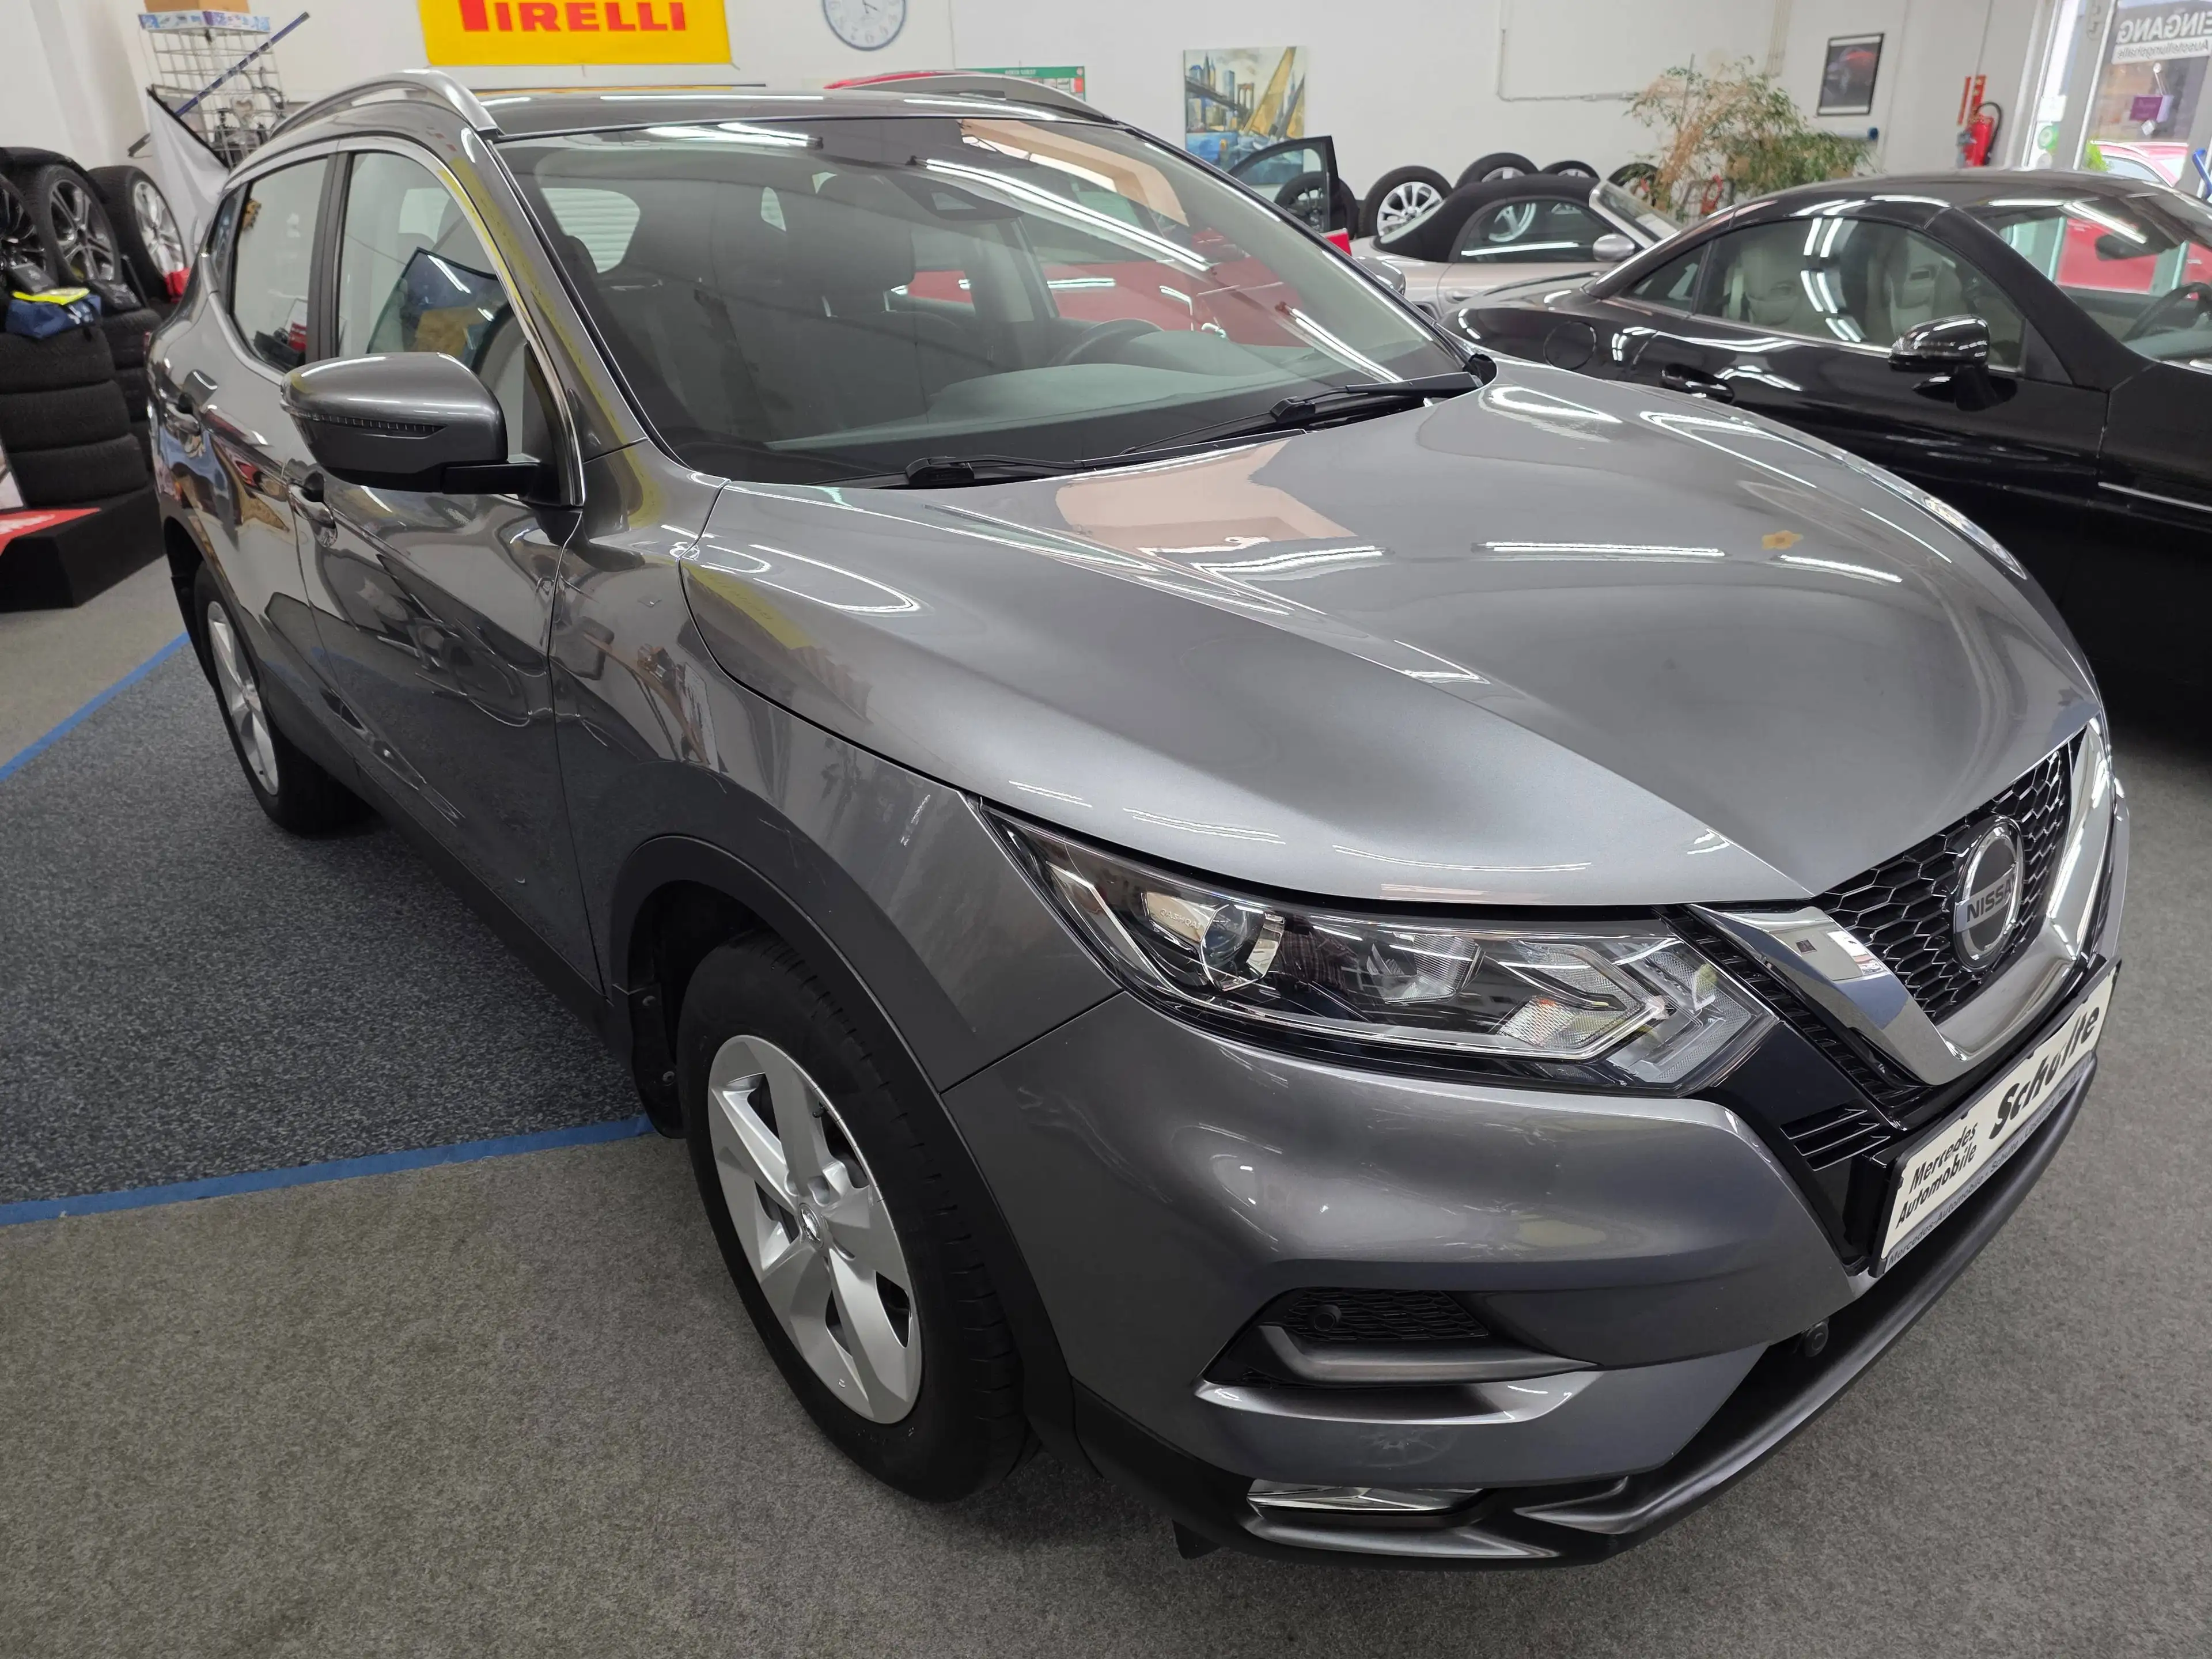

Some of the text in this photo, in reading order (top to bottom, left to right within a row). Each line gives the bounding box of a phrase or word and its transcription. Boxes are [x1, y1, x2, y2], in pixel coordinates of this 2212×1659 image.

[1967, 877, 2012, 923] NISSA
[1908, 1122, 1978, 1194] Mercedes
[1988, 1007, 2100, 1140] Schulte
[1895, 1143, 1977, 1229] Automobile
